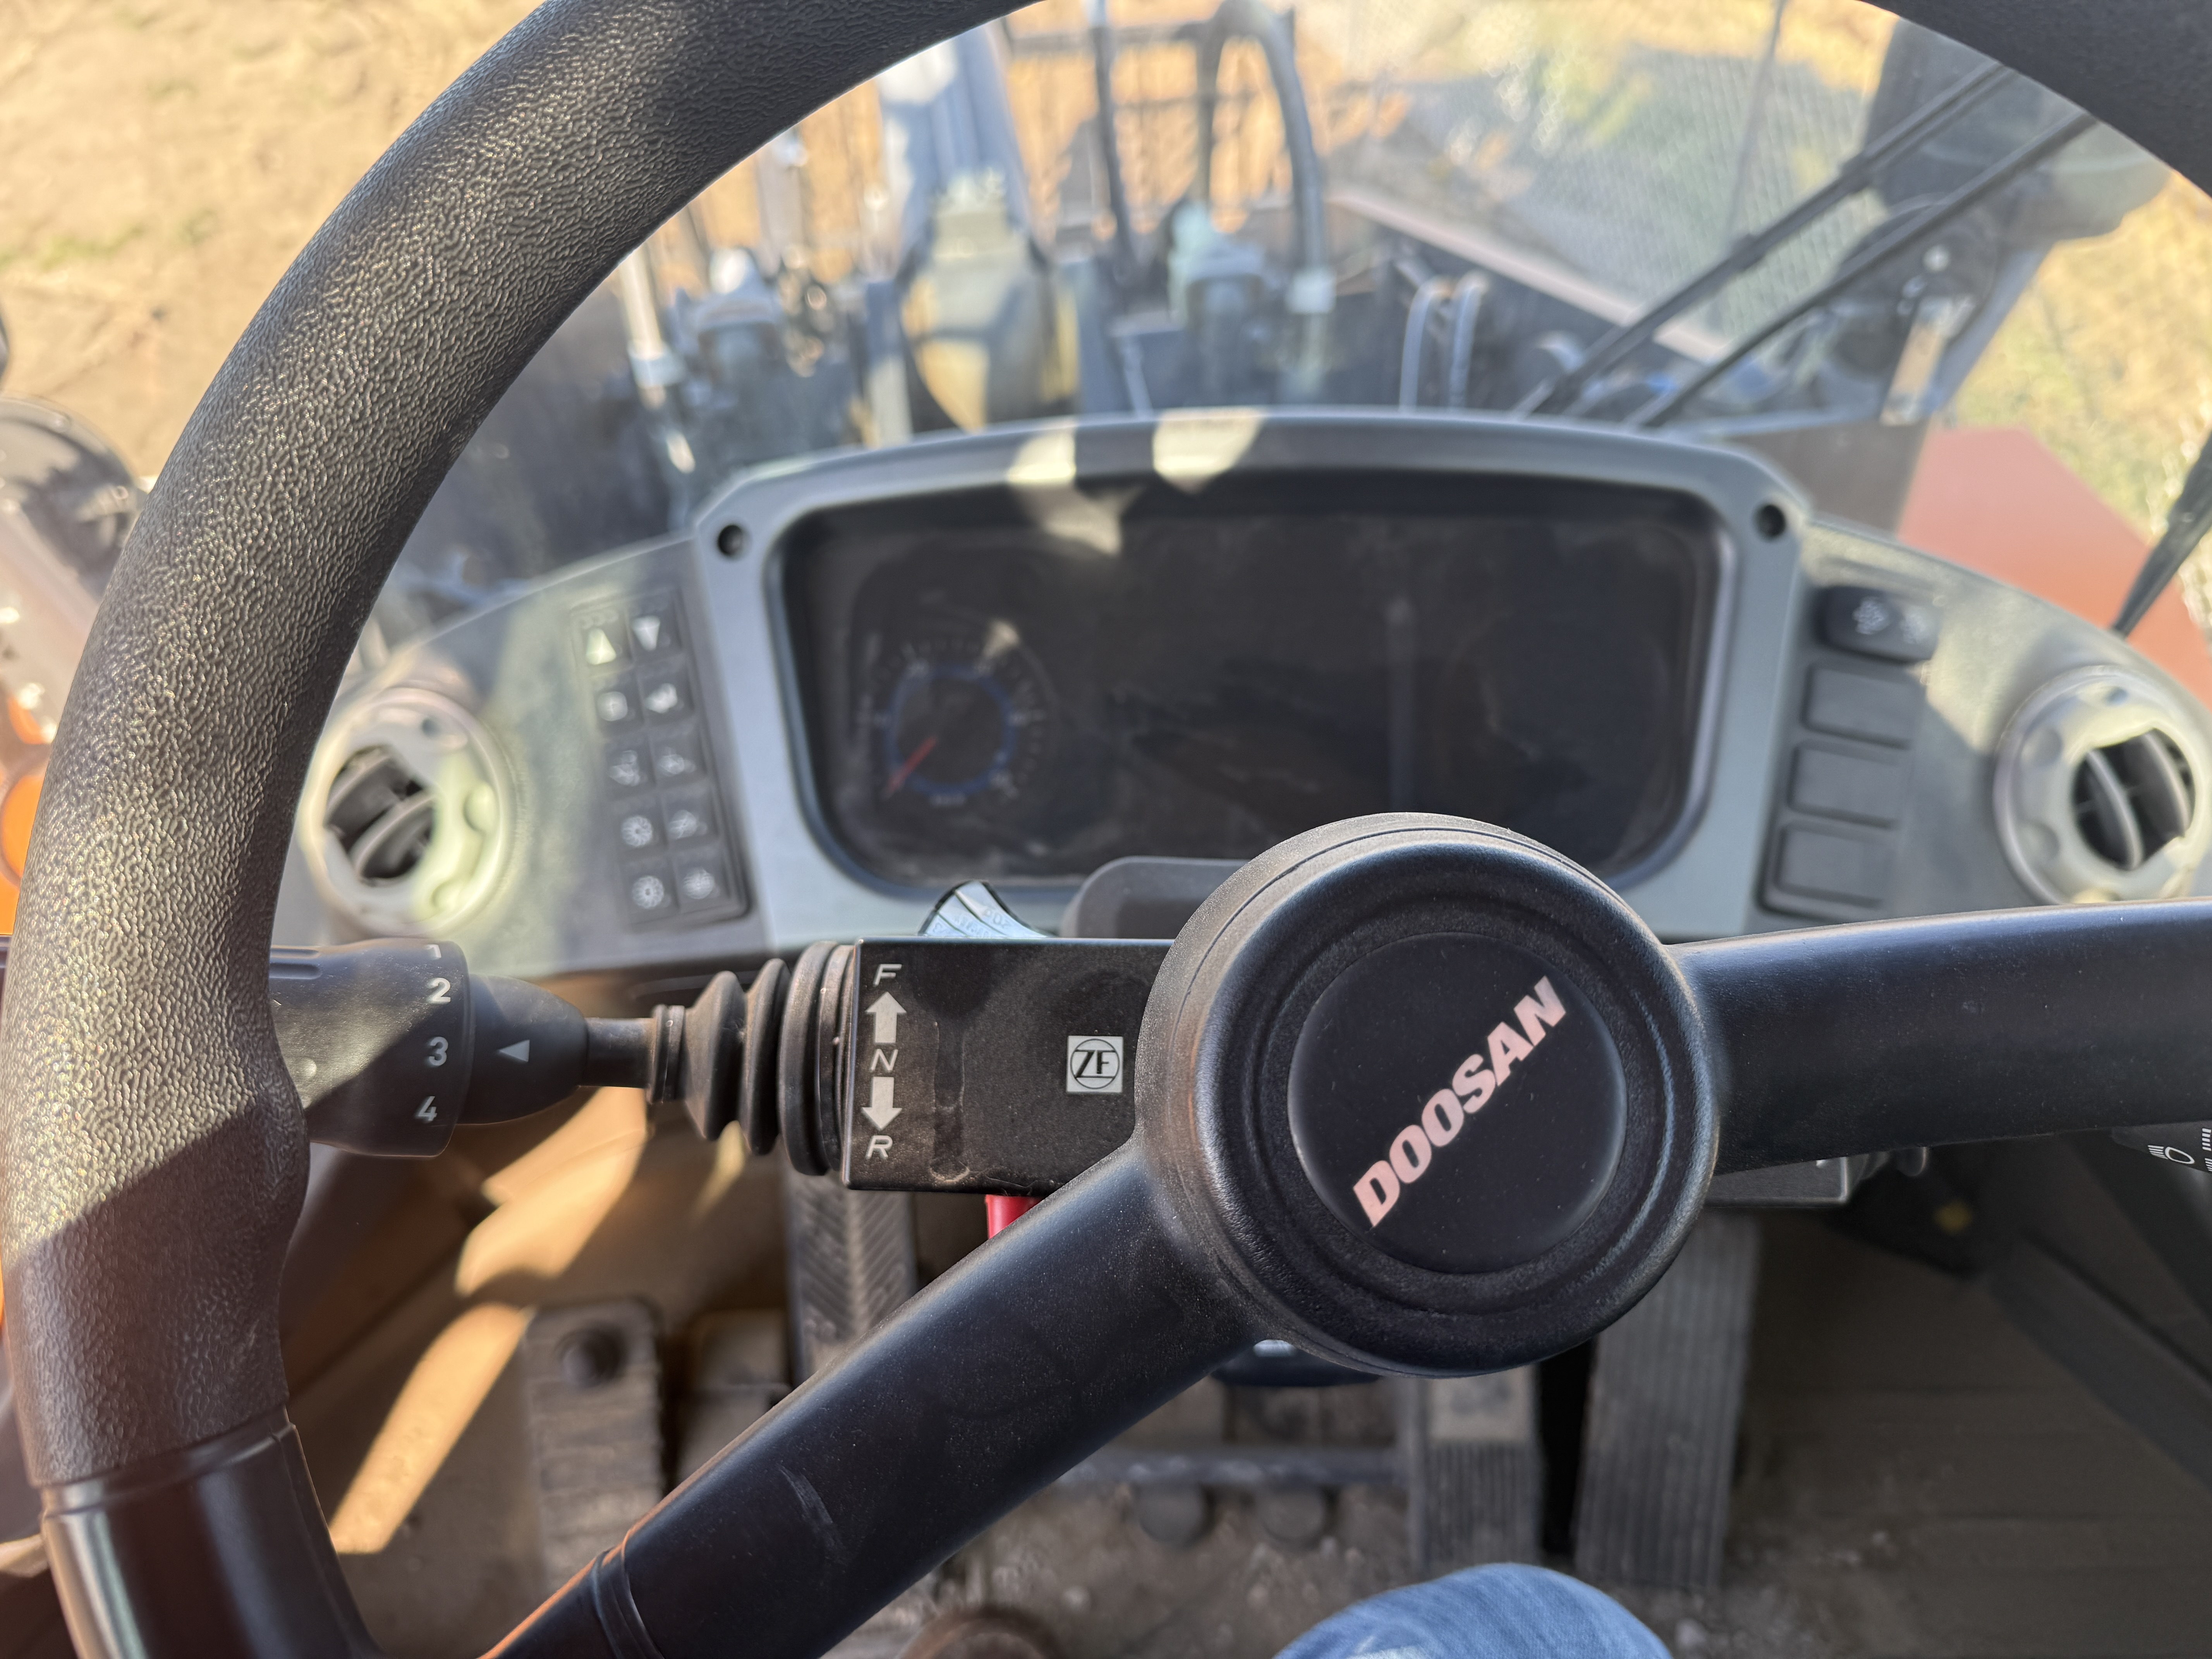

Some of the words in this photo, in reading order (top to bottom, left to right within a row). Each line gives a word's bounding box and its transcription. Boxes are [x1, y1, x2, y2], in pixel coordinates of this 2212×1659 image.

[425, 944, 441, 959] 1
[874, 964, 902, 985] F
[428, 978, 450, 1003] 2
[428, 1037, 448, 1066] 3
[871, 1049, 898, 1072] N
[417, 1096, 437, 1121] 4
[1353, 977, 1566, 1226] DOOSAN
[867, 1135, 893, 1159] R
